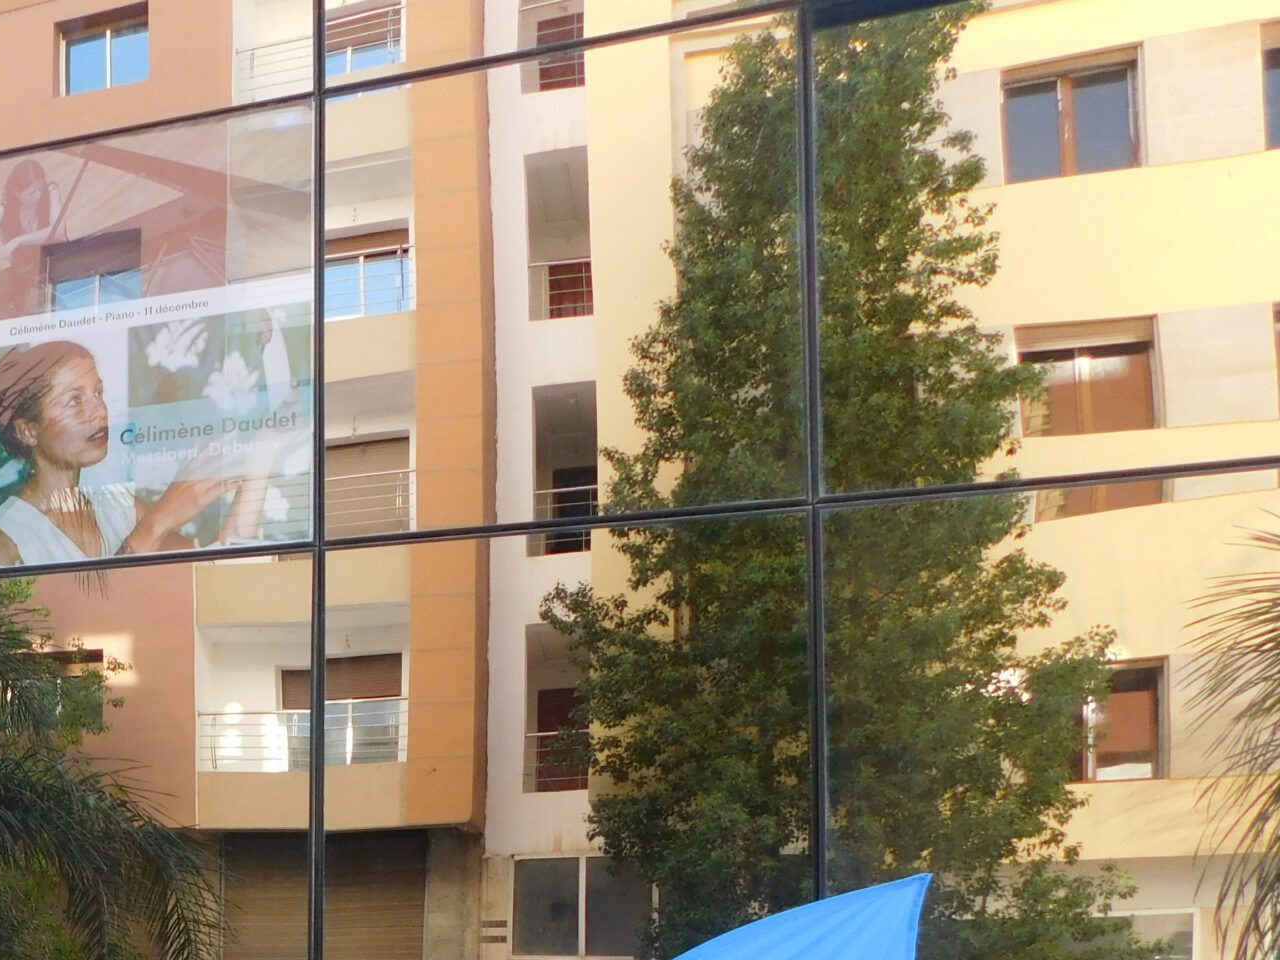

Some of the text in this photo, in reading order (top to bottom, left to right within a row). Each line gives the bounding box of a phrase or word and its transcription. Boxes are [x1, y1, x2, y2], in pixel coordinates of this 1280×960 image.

[10, 300, 209, 336] Célimène Daudet Piano 11 décembre
[120, 411, 297, 445] Célimène Daudet
